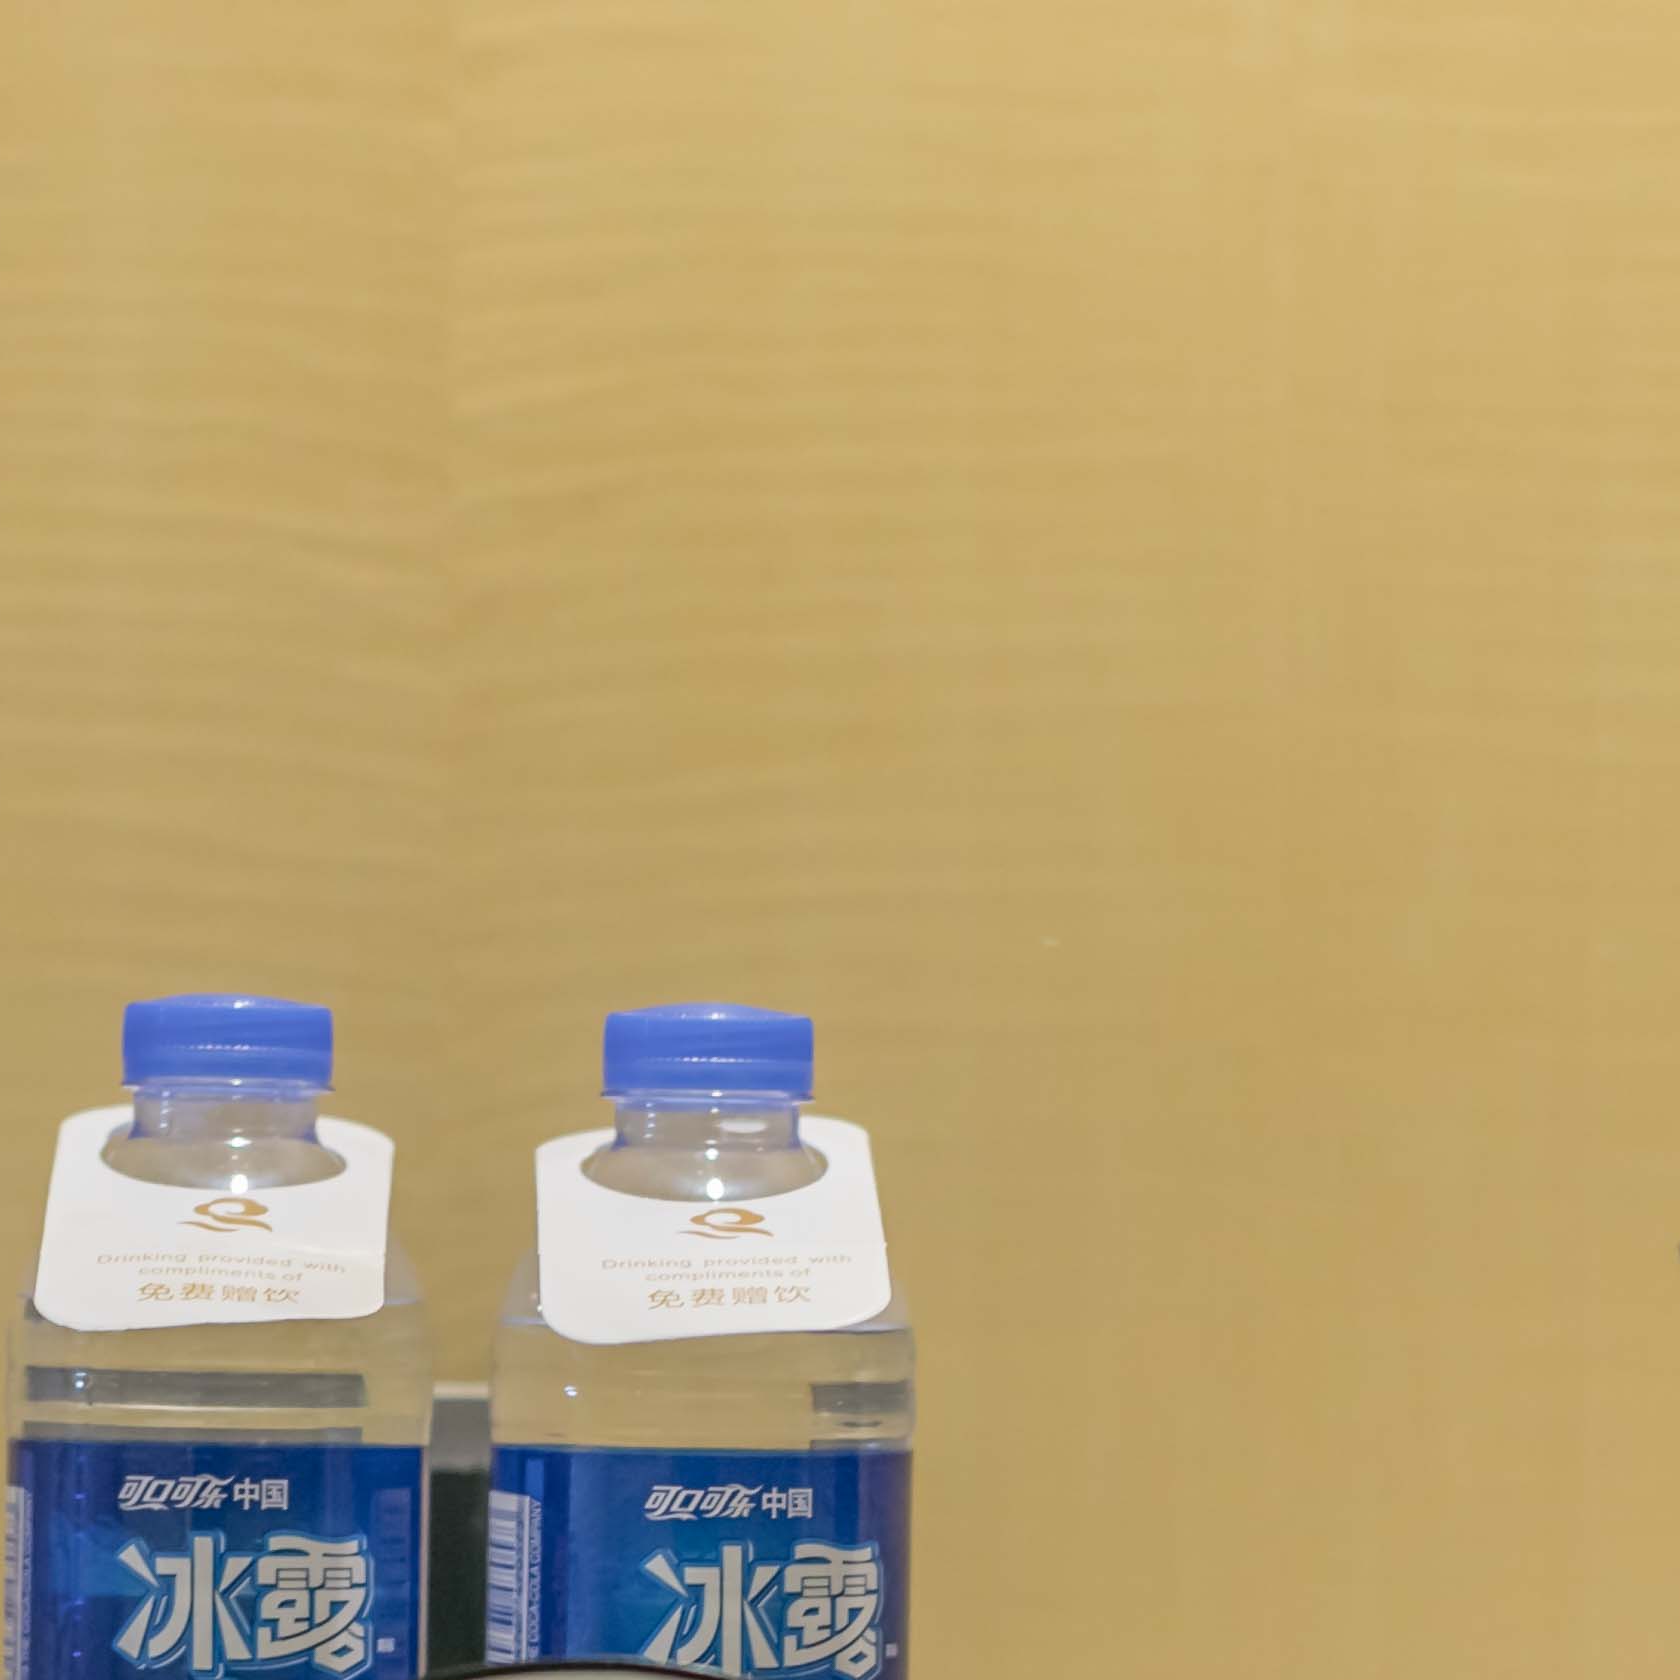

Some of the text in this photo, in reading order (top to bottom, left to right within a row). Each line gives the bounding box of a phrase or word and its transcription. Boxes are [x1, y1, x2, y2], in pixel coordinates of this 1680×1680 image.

[198, 1253, 293, 1268] provided
[601, 1254, 853, 1270] Drinking provided with
[138, 1265, 276, 1281] compliments
[645, 1267, 812, 1281] compliments of
[137, 1282, 301, 1303] 免费赠饮
[647, 1285, 812, 1311] 免费赠饮
[116, 1534, 368, 1675] 冰露
[642, 1543, 880, 1680] 冰露
